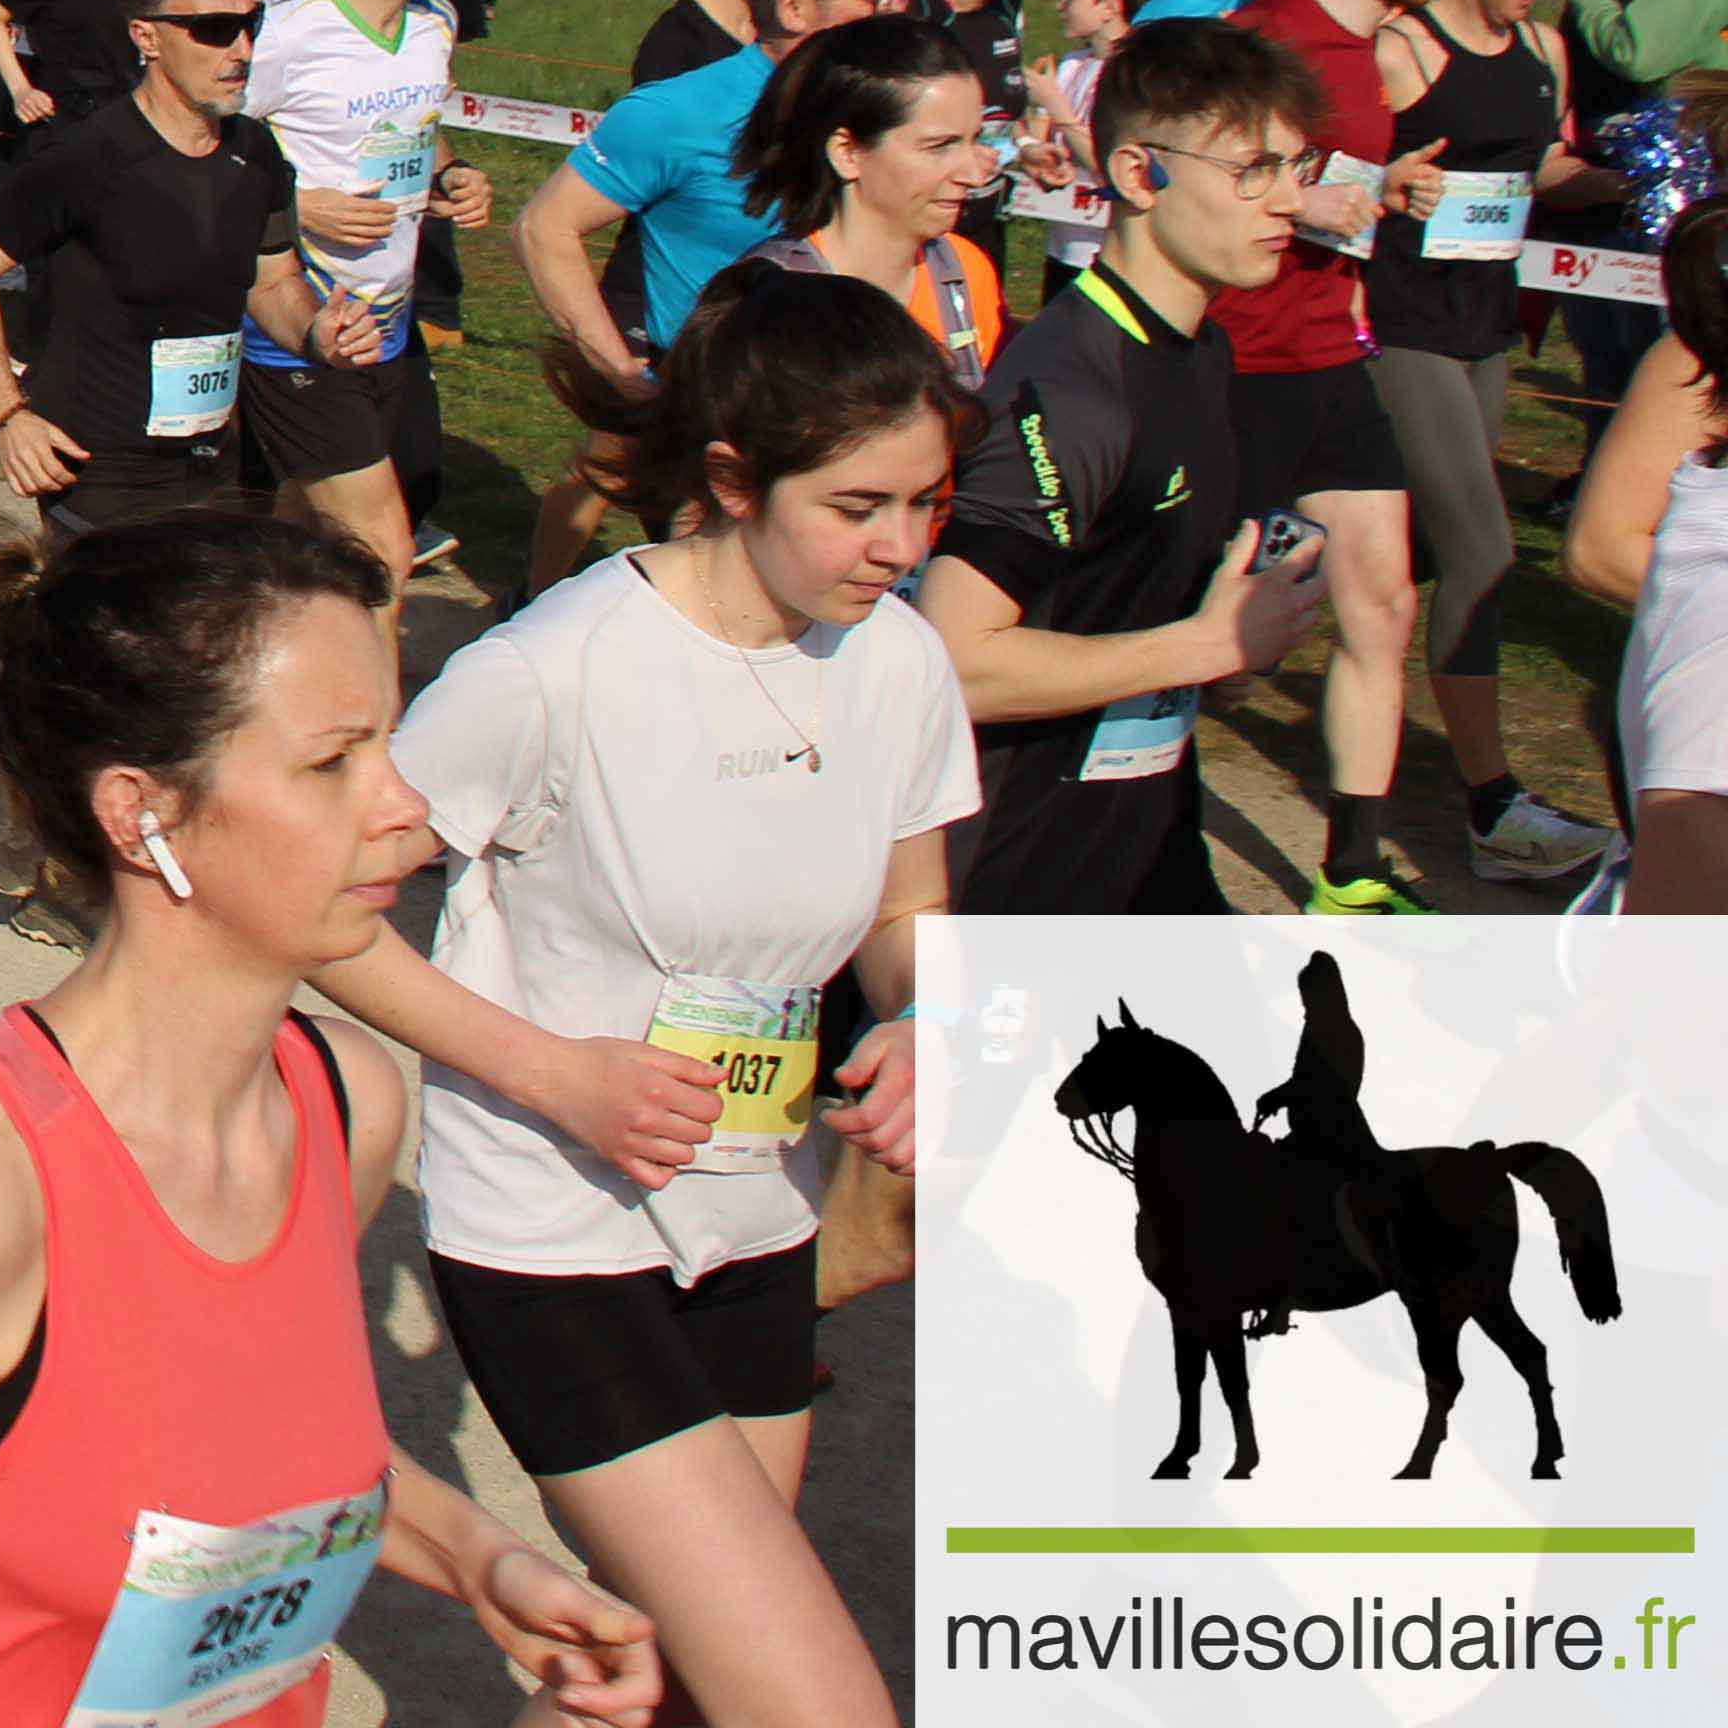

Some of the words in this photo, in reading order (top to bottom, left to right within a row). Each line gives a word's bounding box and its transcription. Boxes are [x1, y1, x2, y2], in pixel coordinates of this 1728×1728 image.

[1463, 204, 1510, 224] 3006
[187, 369, 230, 395] 3076
[715, 745, 781, 781] RUN
[187, 1576, 313, 1658] 2678
